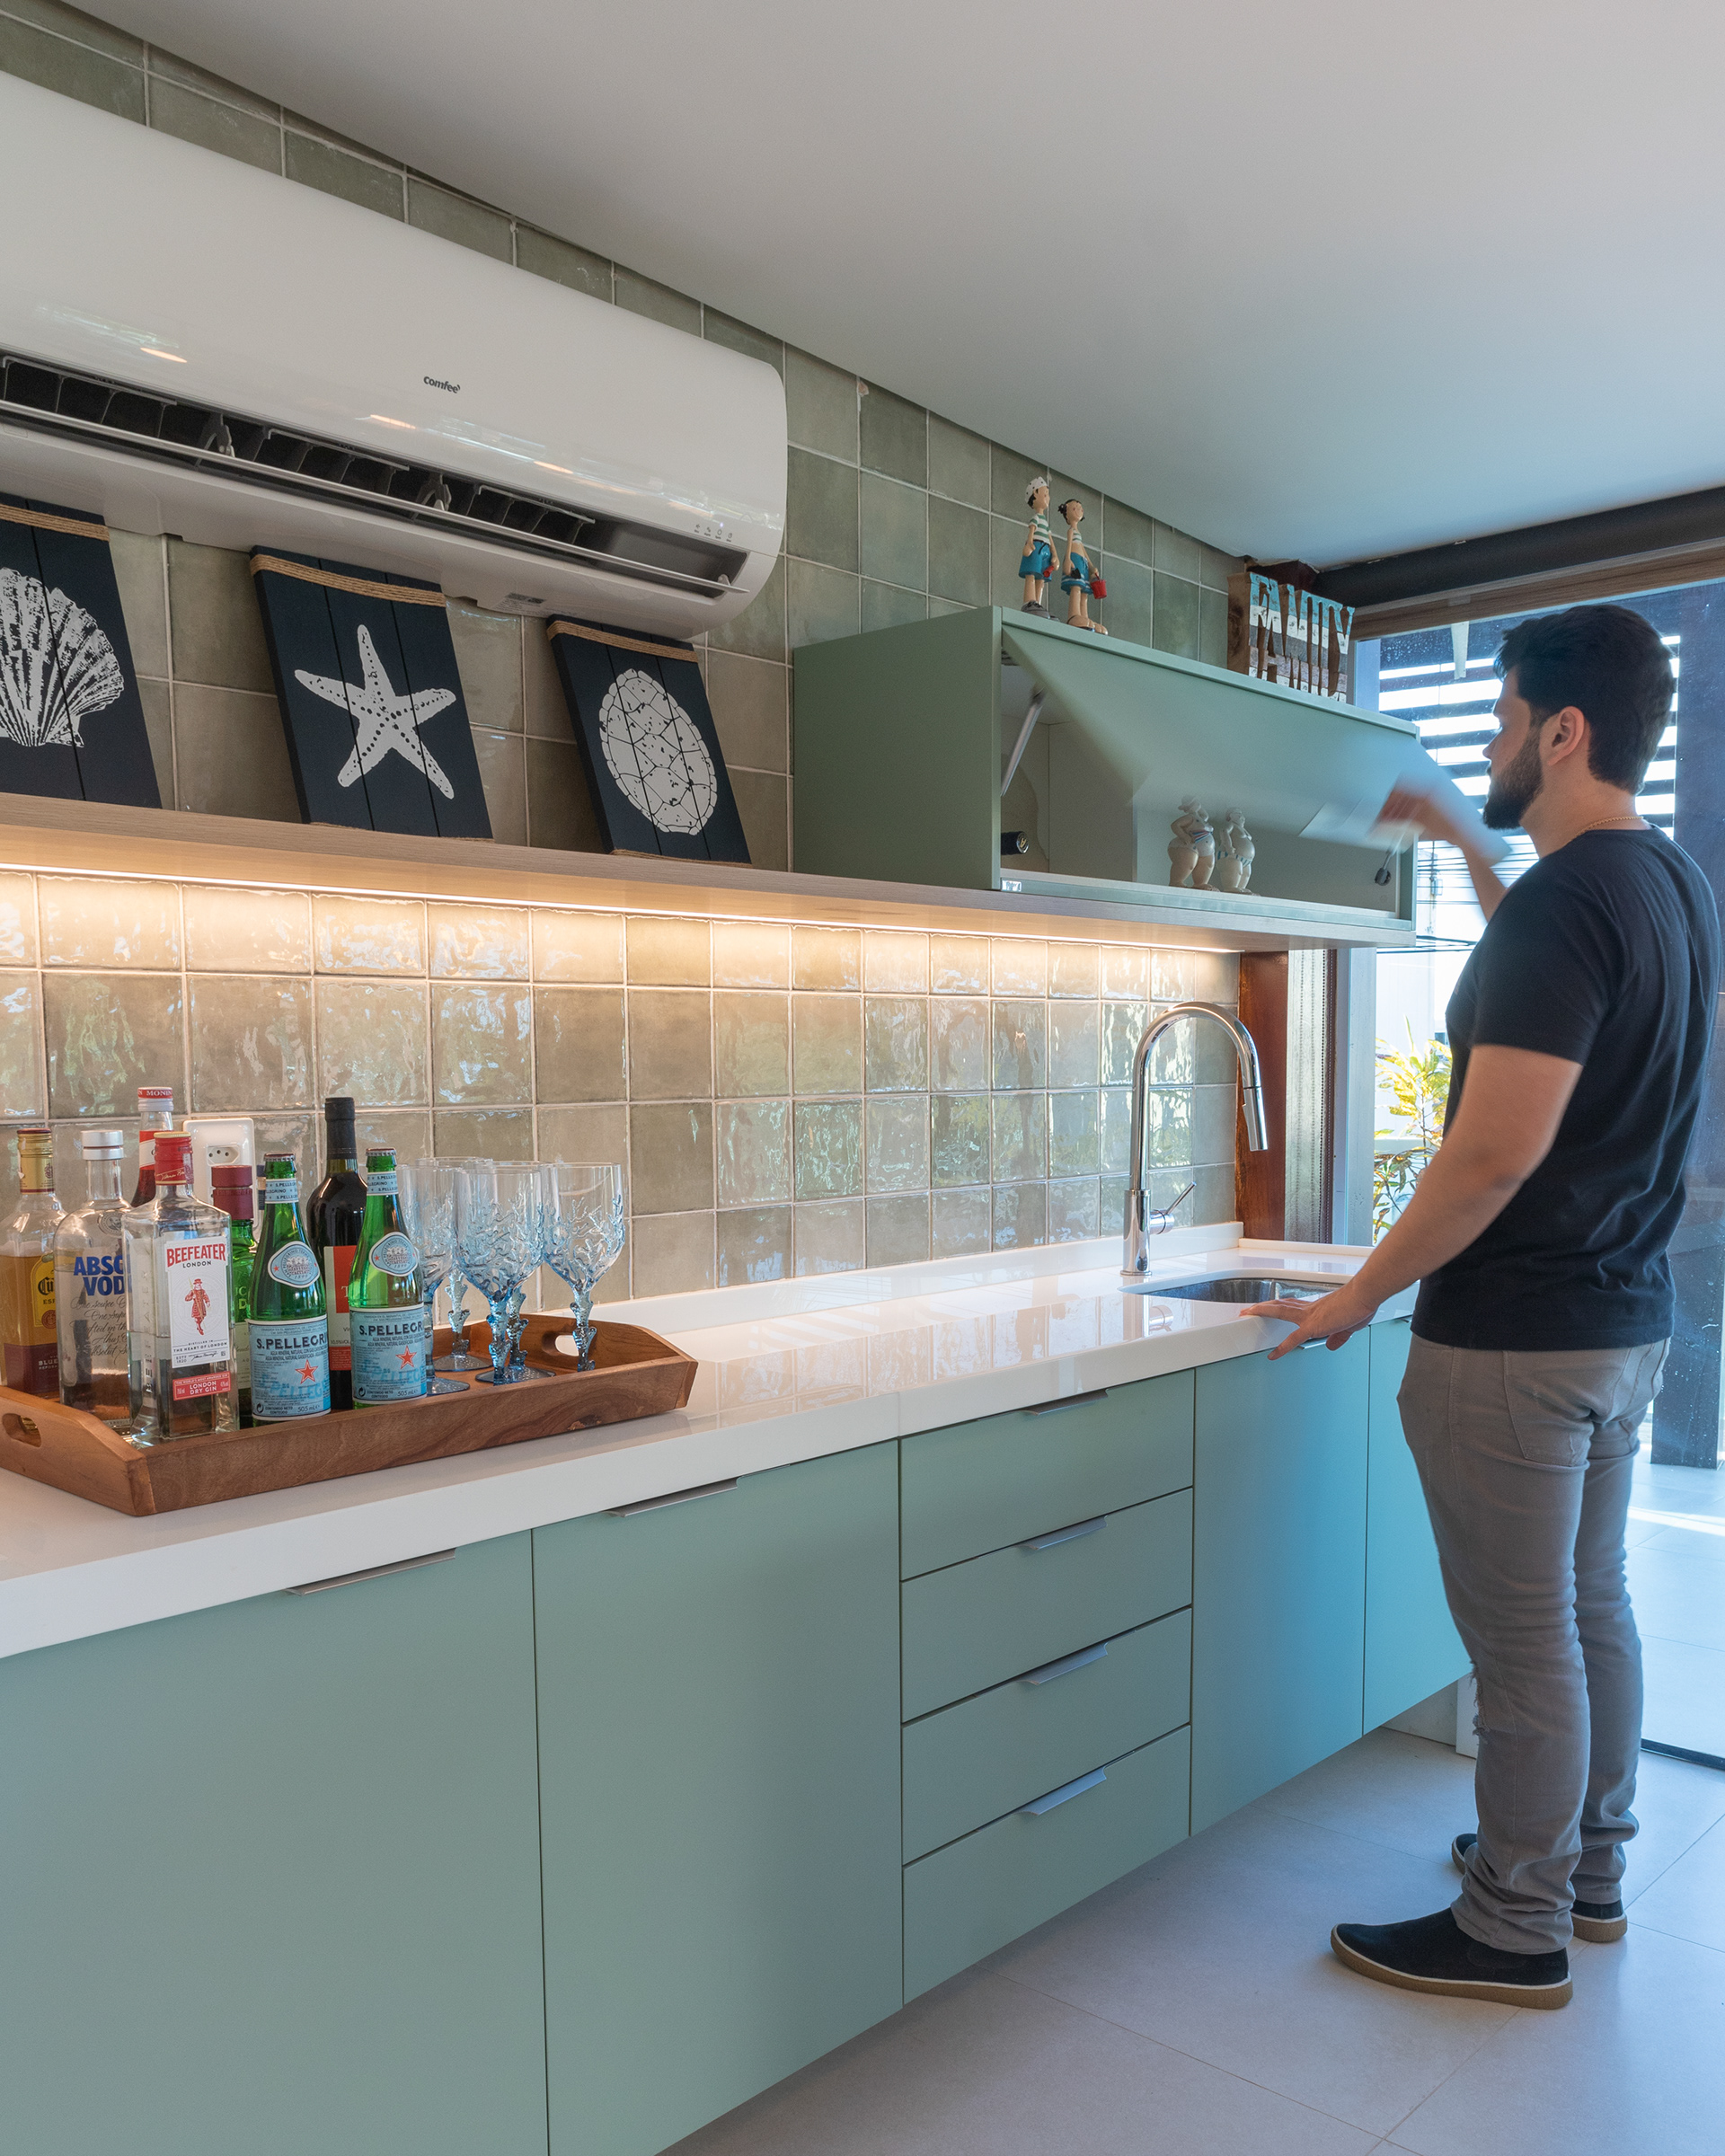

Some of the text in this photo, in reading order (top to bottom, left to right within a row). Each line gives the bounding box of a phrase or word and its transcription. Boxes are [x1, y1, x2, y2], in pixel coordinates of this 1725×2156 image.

[1249, 571, 1355, 702] FAMILY
[166, 1243, 226, 1268] BEEFEATER
[182, 1260, 212, 1268] LONDON
[83, 1276, 125, 1296] VOD
[190, 1381, 217, 1390] LONDON
